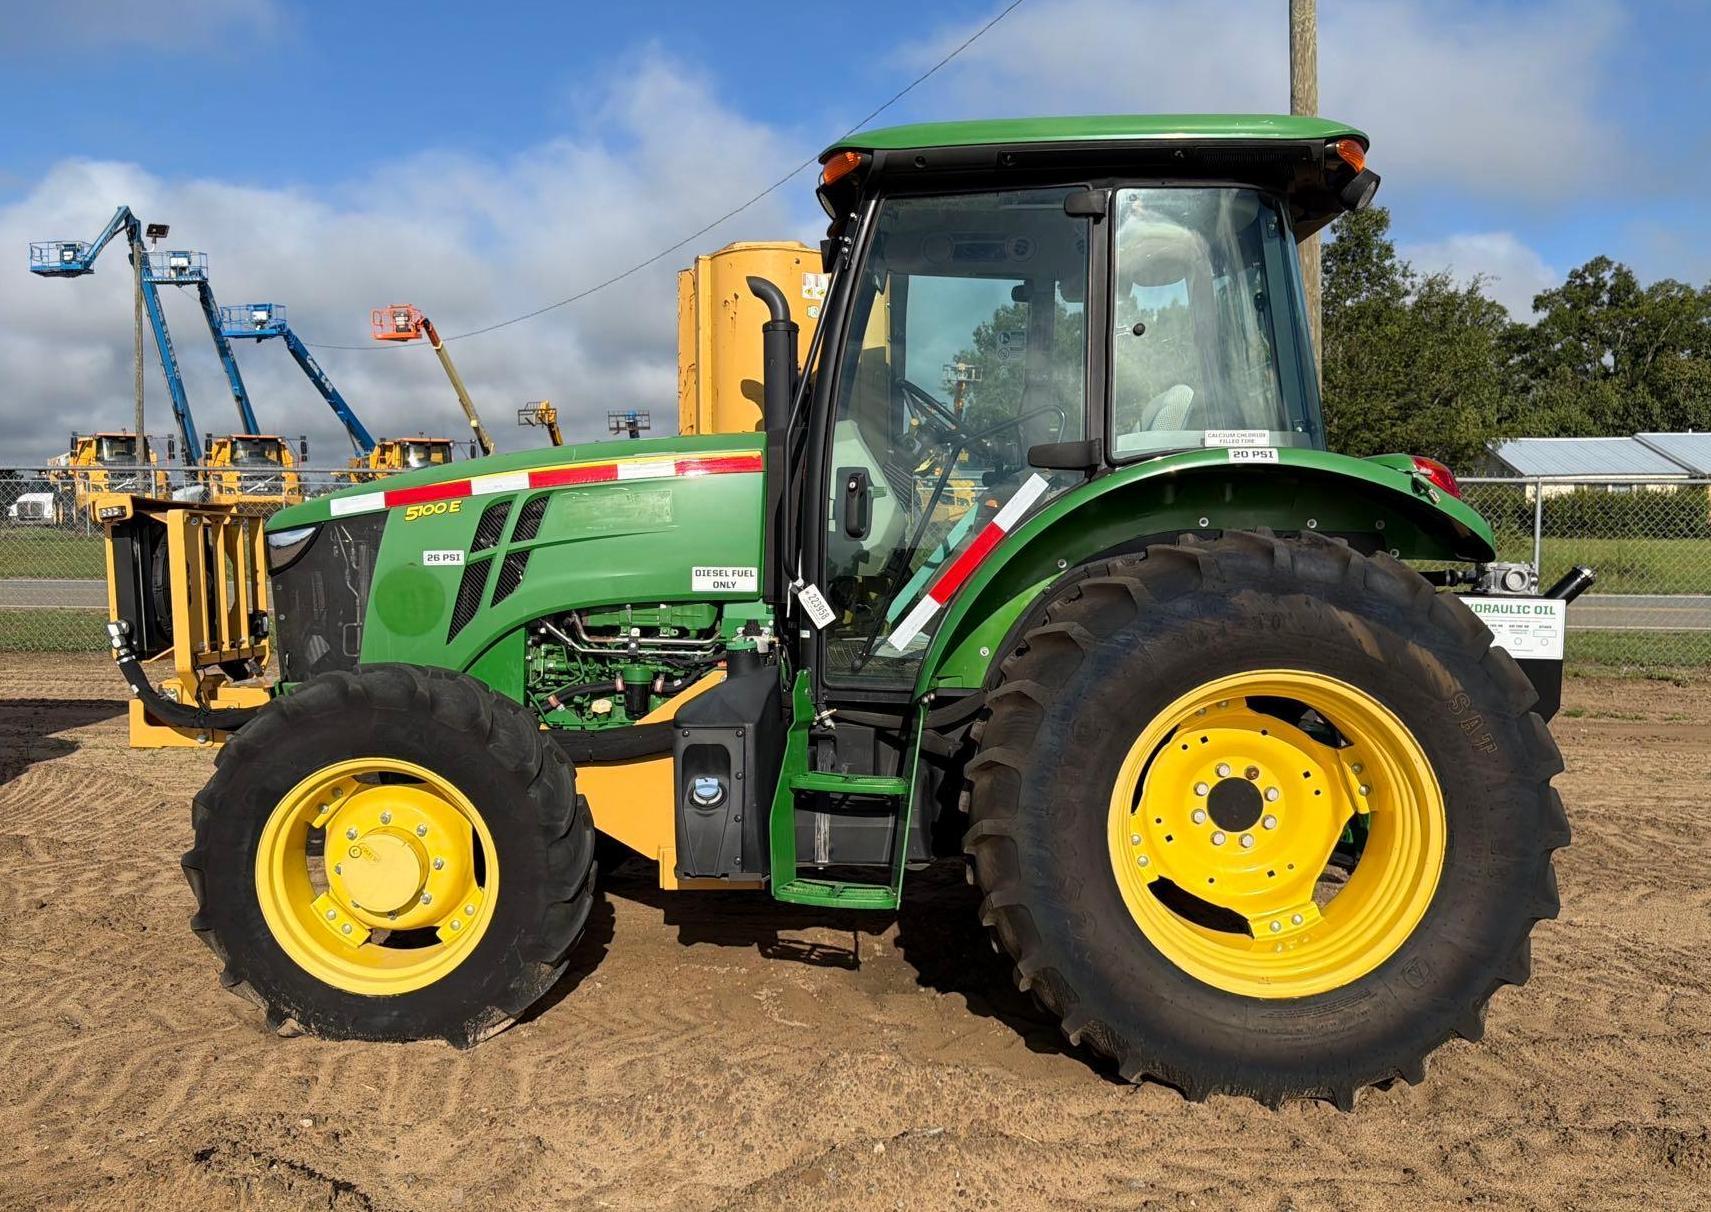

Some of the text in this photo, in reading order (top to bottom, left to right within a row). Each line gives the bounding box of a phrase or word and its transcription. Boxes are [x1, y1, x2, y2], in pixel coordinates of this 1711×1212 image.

[1233, 450, 1274, 459] 20 PSI
[404, 500, 462, 521] 5100 E
[427, 553, 461, 562] 26 PSI
[695, 569, 755, 578] DIESEL FUEL
[712, 580, 737, 589] ONLY
[1471, 603, 1556, 615] DRAULIC OIL
